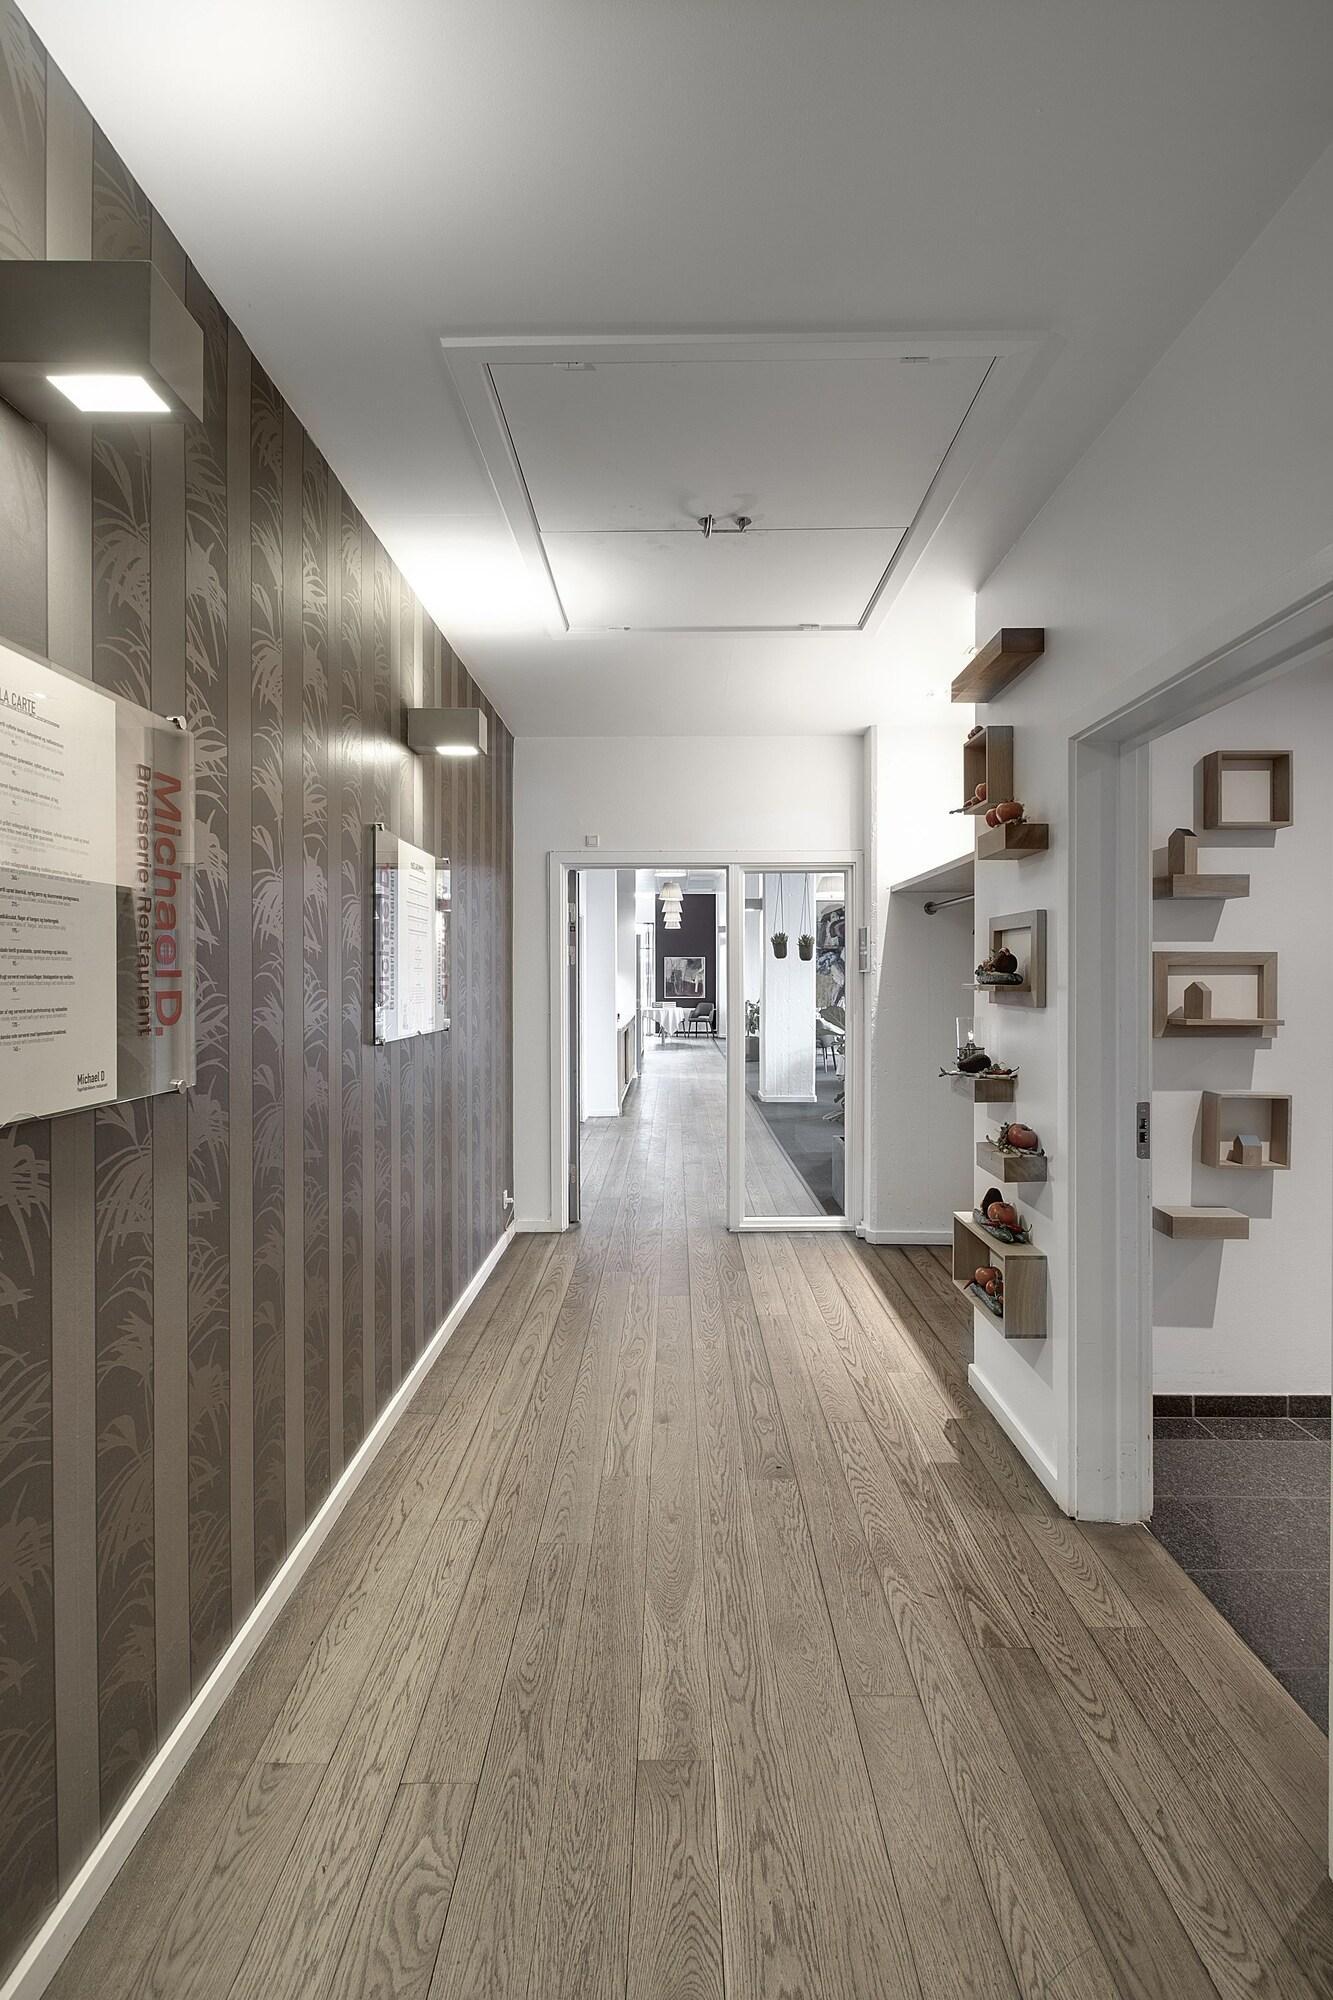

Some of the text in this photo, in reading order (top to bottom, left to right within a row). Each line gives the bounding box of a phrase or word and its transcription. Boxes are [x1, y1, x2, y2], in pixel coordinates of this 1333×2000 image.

[11, 692, 36, 715] CARTE
[136, 764, 152, 1036] Brasserie Restaurant
[153, 771, 182, 978] Michael
[77, 1070, 105, 1086] Michael D
